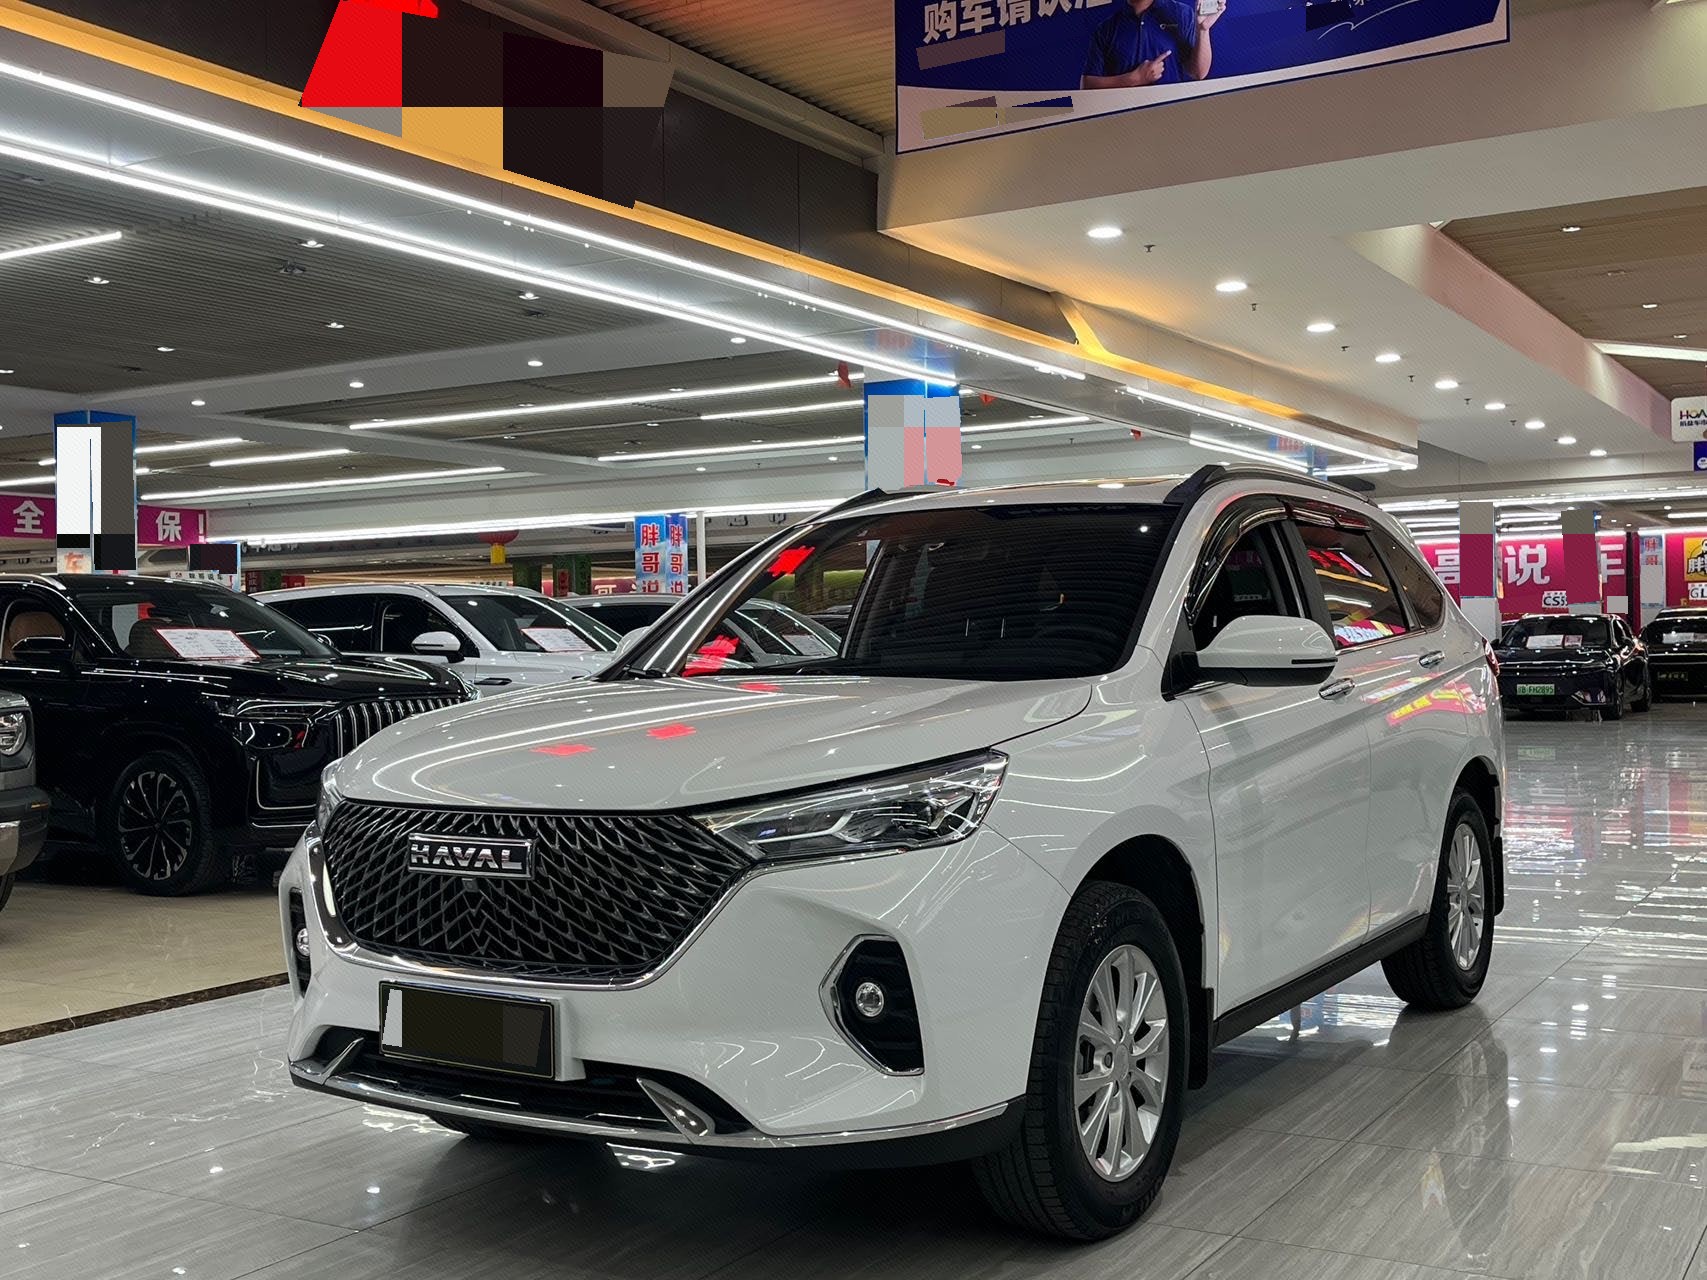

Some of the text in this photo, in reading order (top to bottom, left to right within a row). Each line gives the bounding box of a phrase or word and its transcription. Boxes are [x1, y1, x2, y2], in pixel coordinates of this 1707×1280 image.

[923, 0, 1113, 44] 购车请
[13, 500, 44, 535] 全
[1504, 543, 1550, 586] 说
[410, 843, 523, 870] HAVAL
